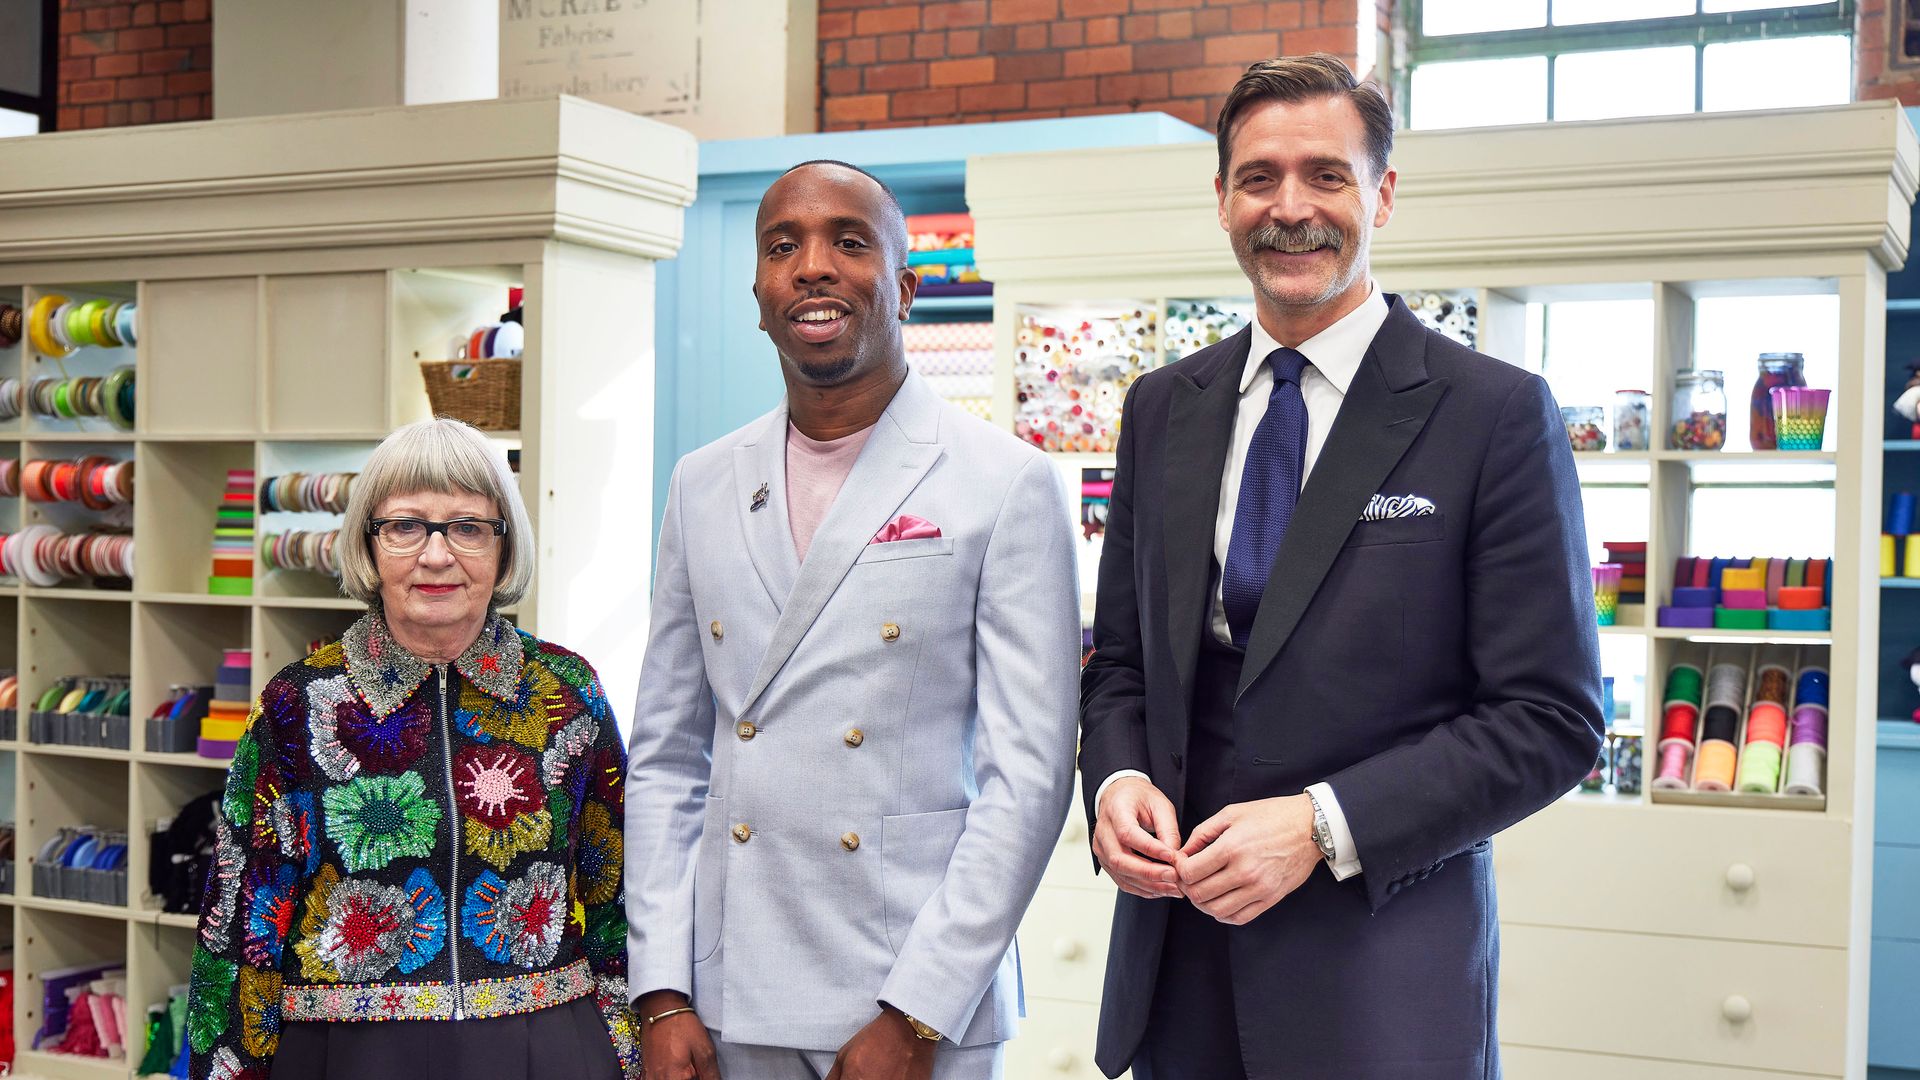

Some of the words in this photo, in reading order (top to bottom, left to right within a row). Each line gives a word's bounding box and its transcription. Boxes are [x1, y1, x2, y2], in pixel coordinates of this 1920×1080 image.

[507, 0, 648, 21] MCRAE
[538, 22, 614, 48] Fabrics
[504, 72, 649, 98] Hardahery
